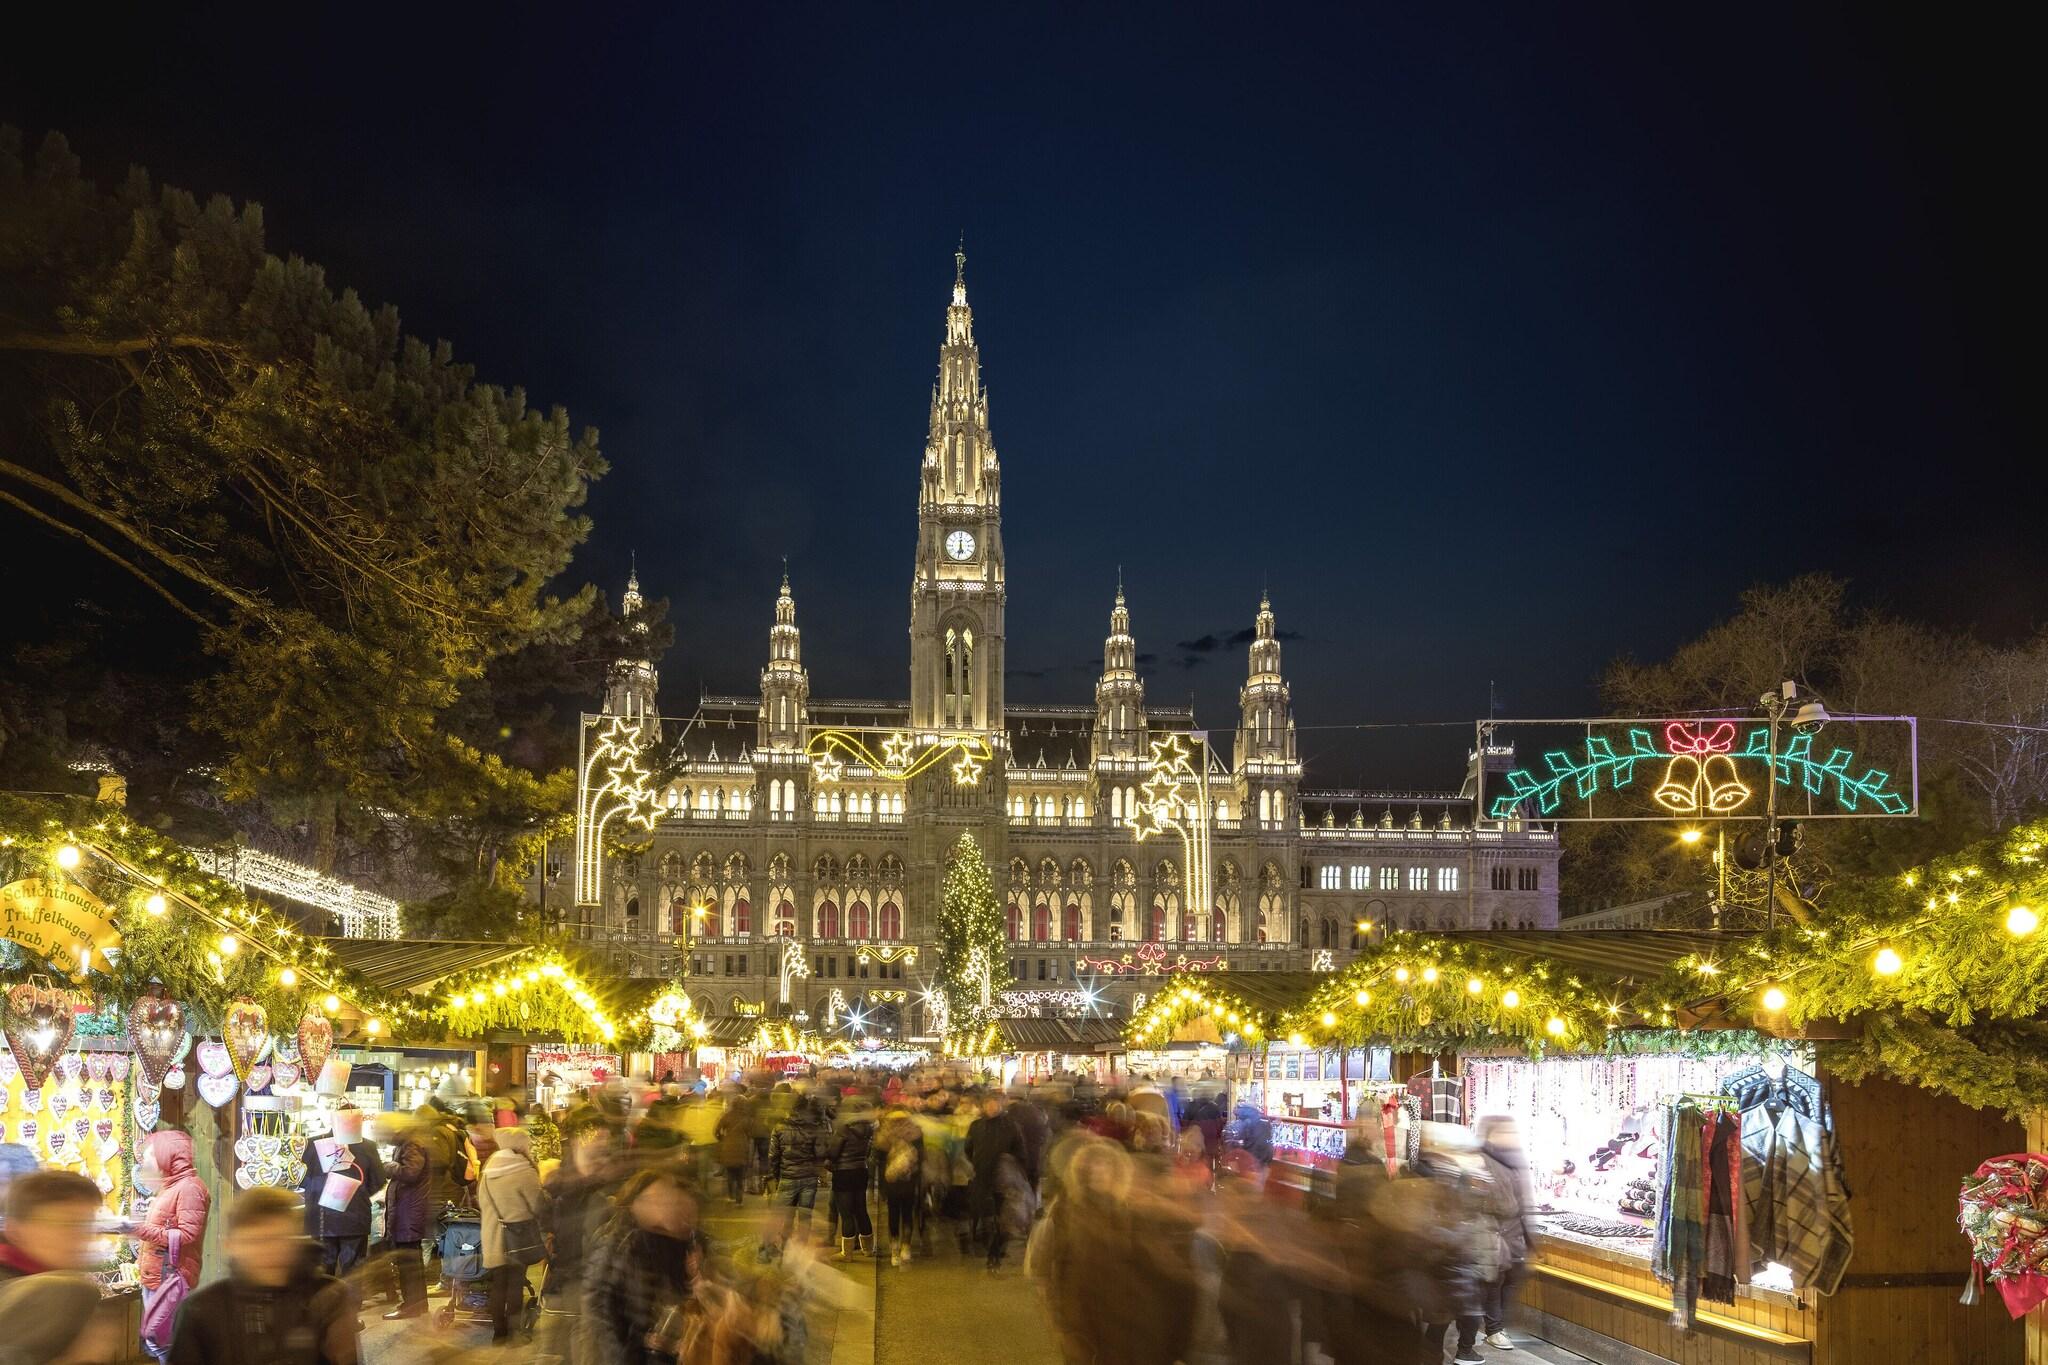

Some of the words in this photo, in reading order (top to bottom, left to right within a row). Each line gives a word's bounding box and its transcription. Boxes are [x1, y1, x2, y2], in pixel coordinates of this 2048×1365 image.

[3, 882, 104, 919] Schichtnougat
[4, 906, 96, 952] Trüffelkugeln
[5, 925, 45, 948] Arab.
